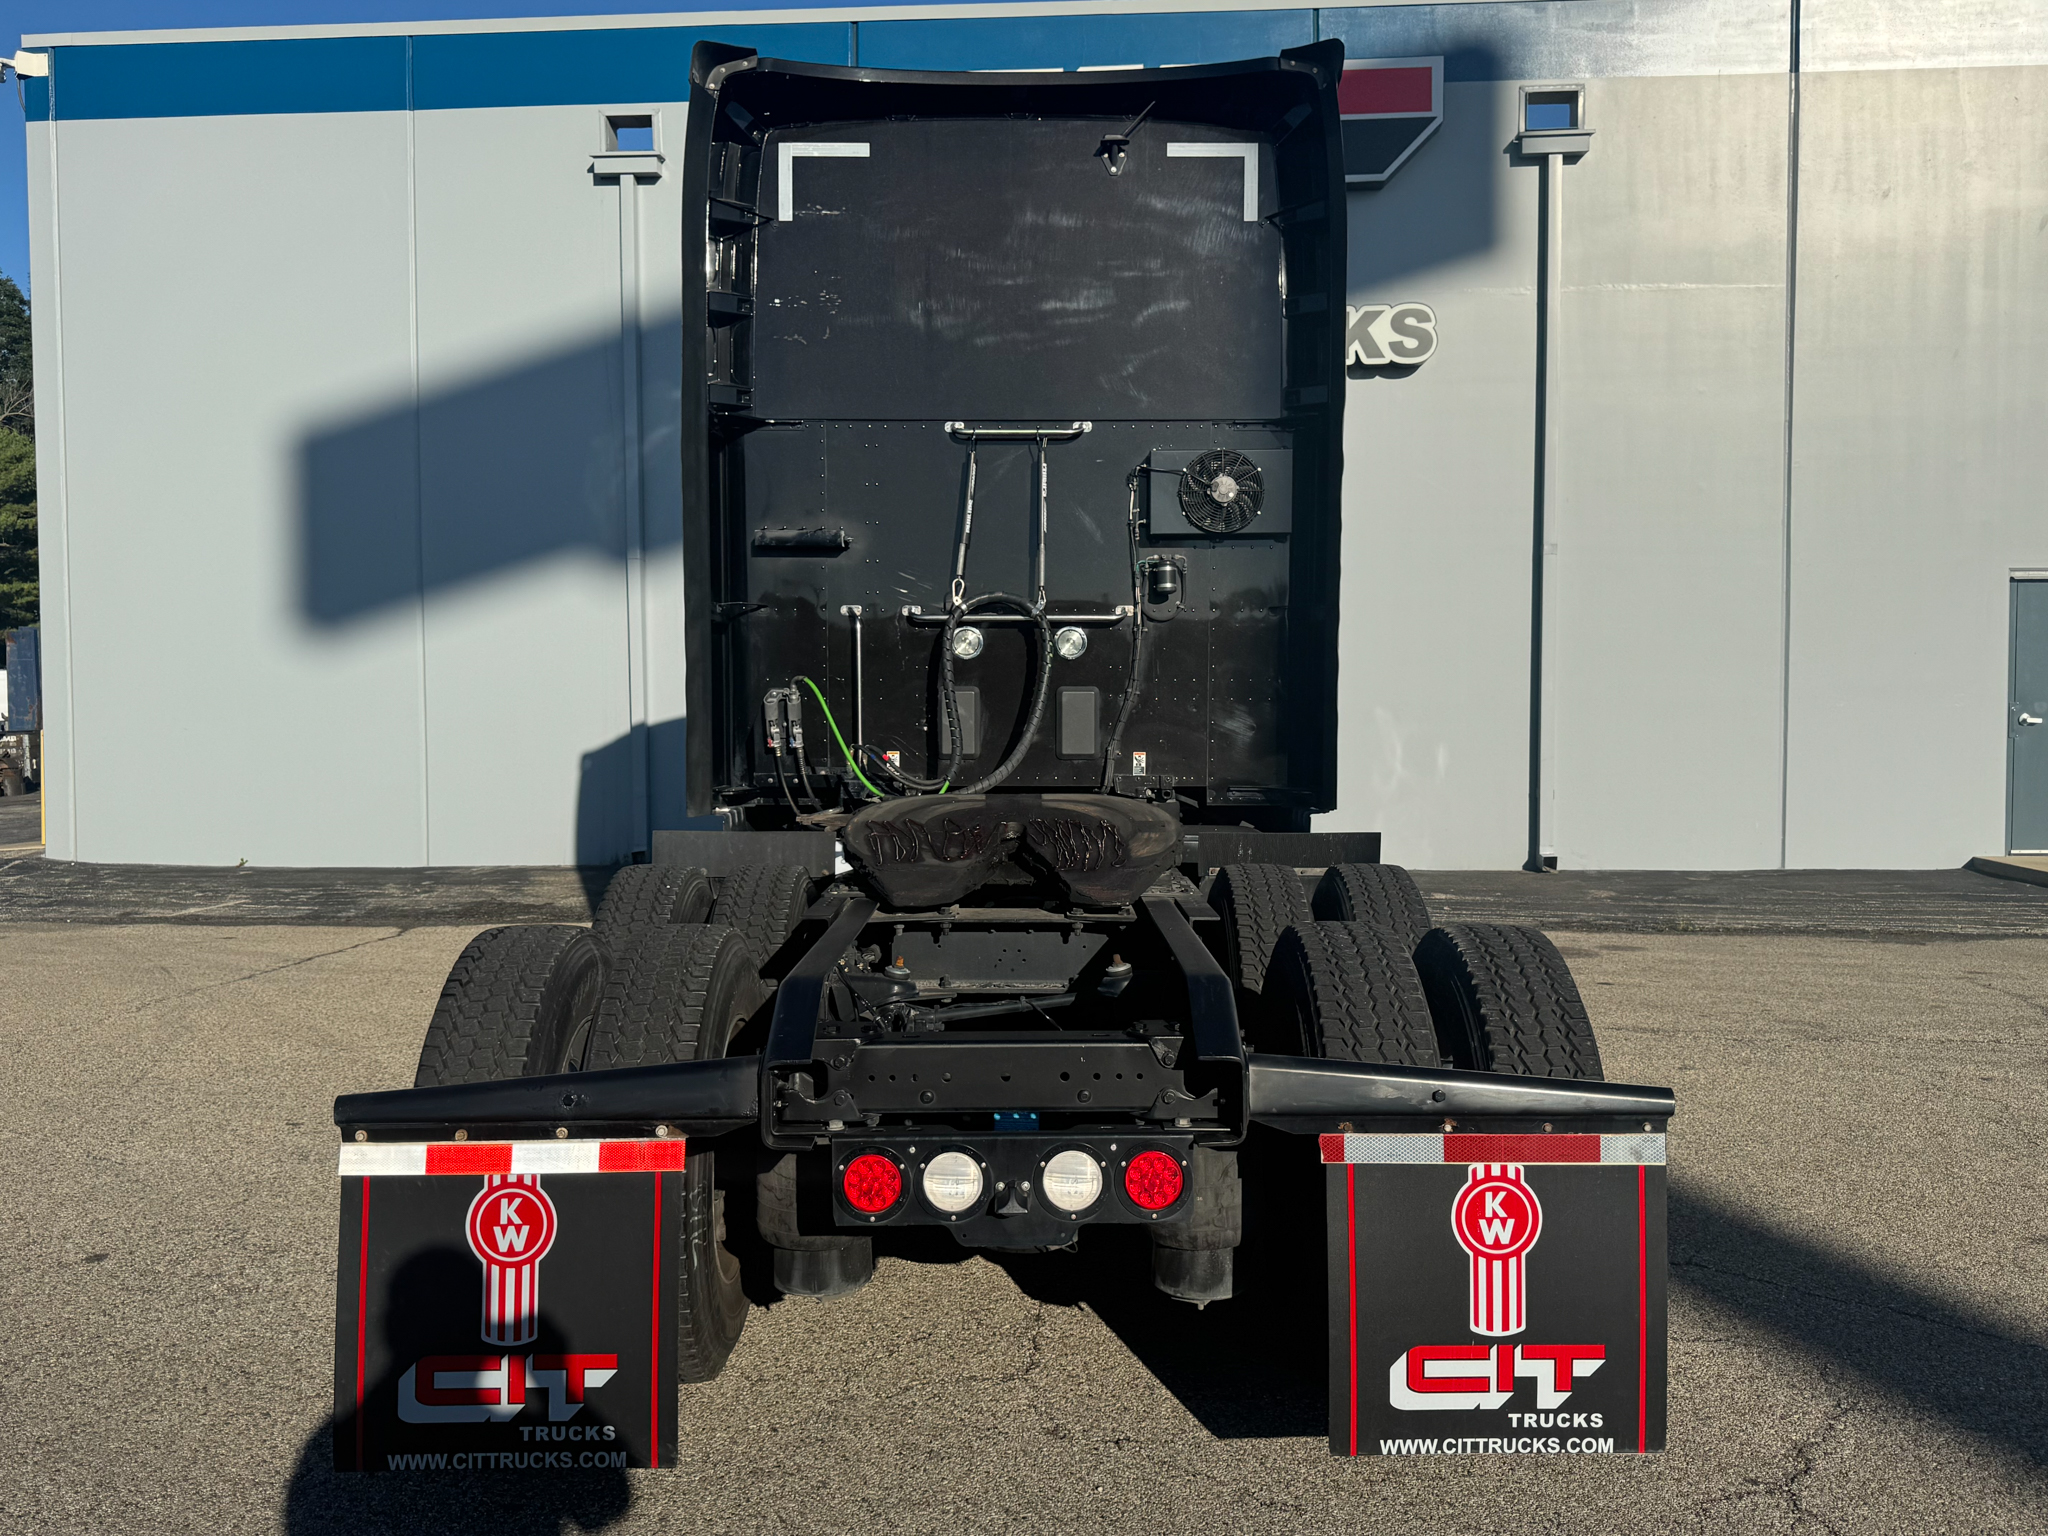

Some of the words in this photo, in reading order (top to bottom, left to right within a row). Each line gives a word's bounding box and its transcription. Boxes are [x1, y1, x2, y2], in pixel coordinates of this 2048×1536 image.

[1389, 1343, 1606, 1410] CIT
[397, 1353, 618, 1423] CIT
[1507, 1412, 1604, 1429] TRUCKS
[518, 1425, 617, 1442] TRUCKS
[1379, 1437, 1614, 1455] WWW.CITTRUCKS.COM
[387, 1451, 628, 1471] WWW.CITTRUCKS.COM
